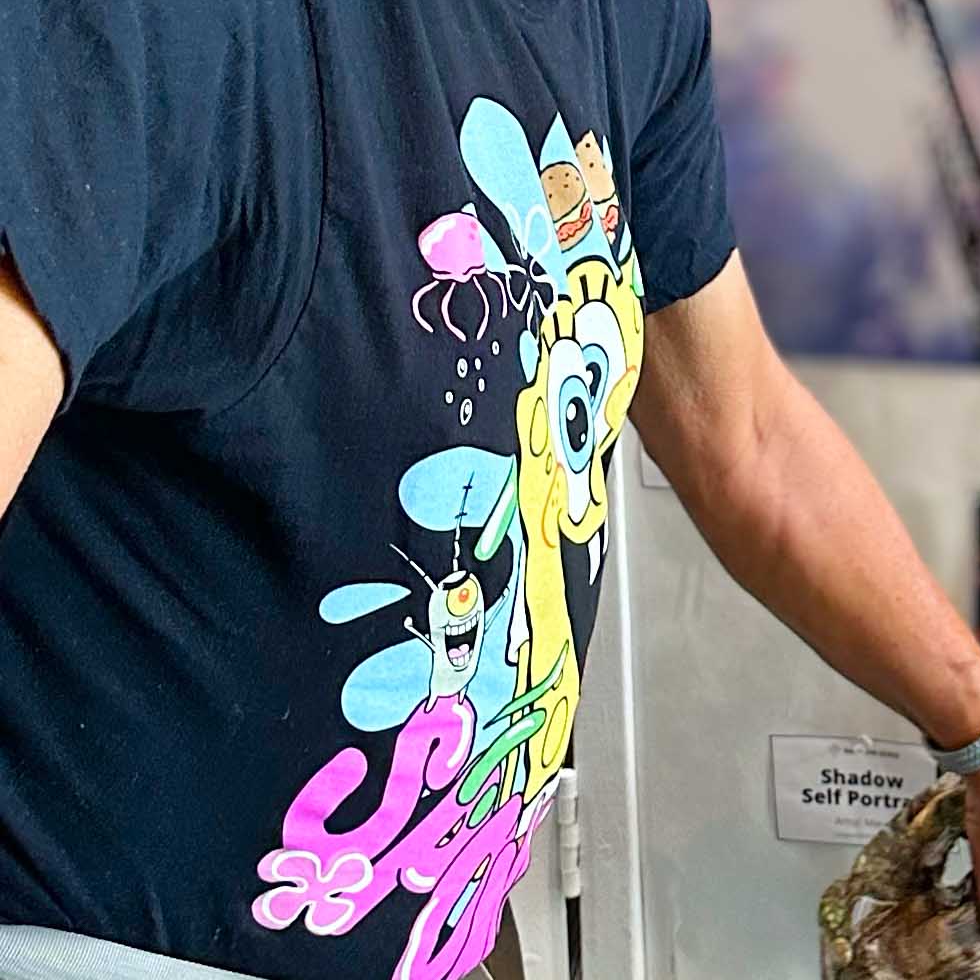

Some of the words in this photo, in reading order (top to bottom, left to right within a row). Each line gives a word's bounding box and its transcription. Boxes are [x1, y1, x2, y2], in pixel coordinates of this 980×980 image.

[821, 767, 904, 789] Shadow
[802, 788, 842, 806] Self
[847, 790, 912, 809] Portra
